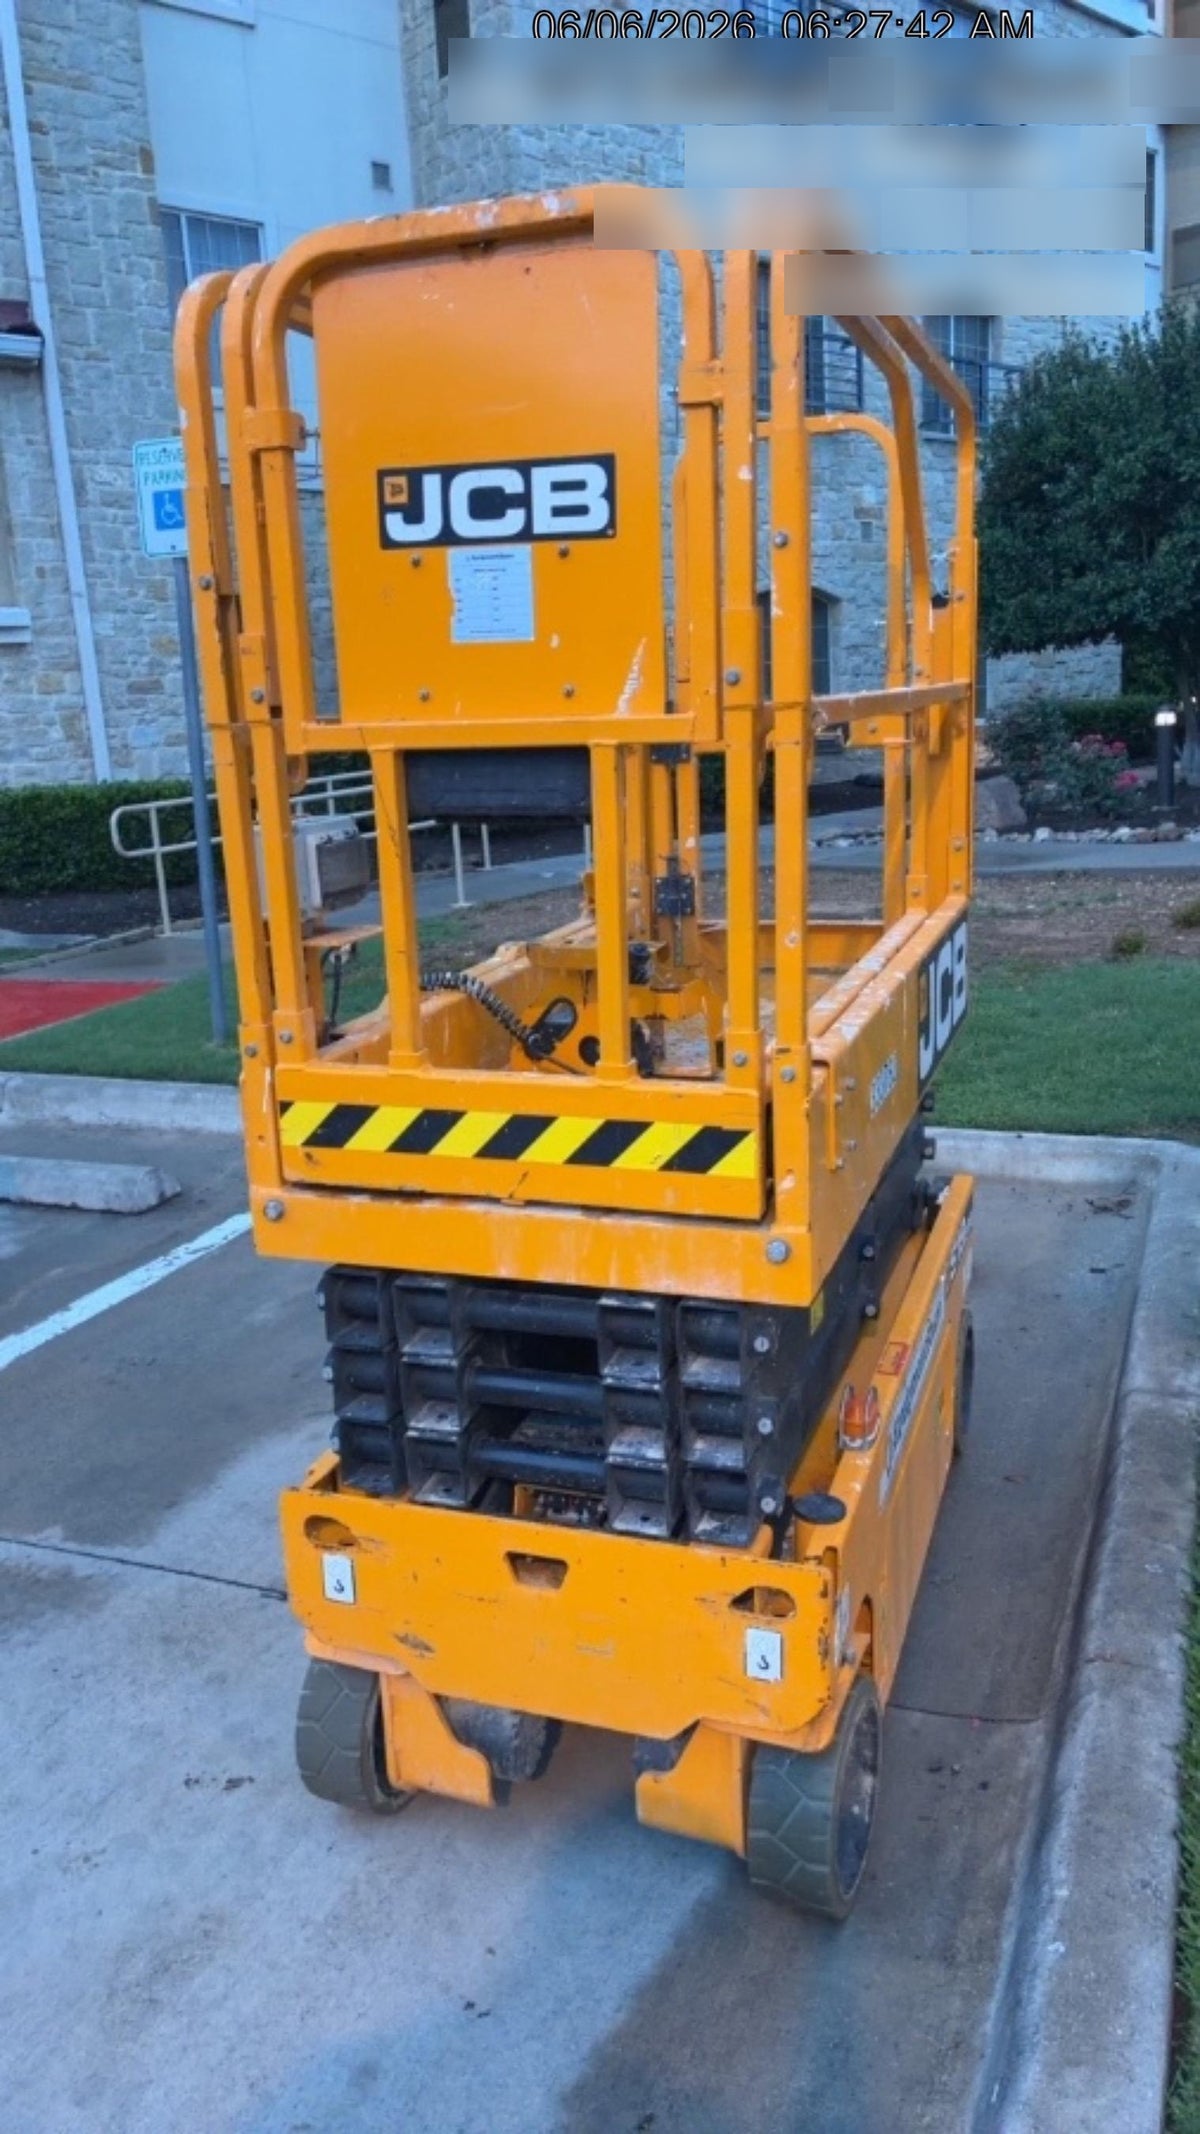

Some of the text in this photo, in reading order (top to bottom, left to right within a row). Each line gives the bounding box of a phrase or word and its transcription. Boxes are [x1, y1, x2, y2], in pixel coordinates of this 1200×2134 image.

[135, 447, 186, 466] RESERVE
[143, 468, 185, 486] PARKIN
[384, 462, 611, 543] JCB
[920, 920, 967, 1080] JCB
